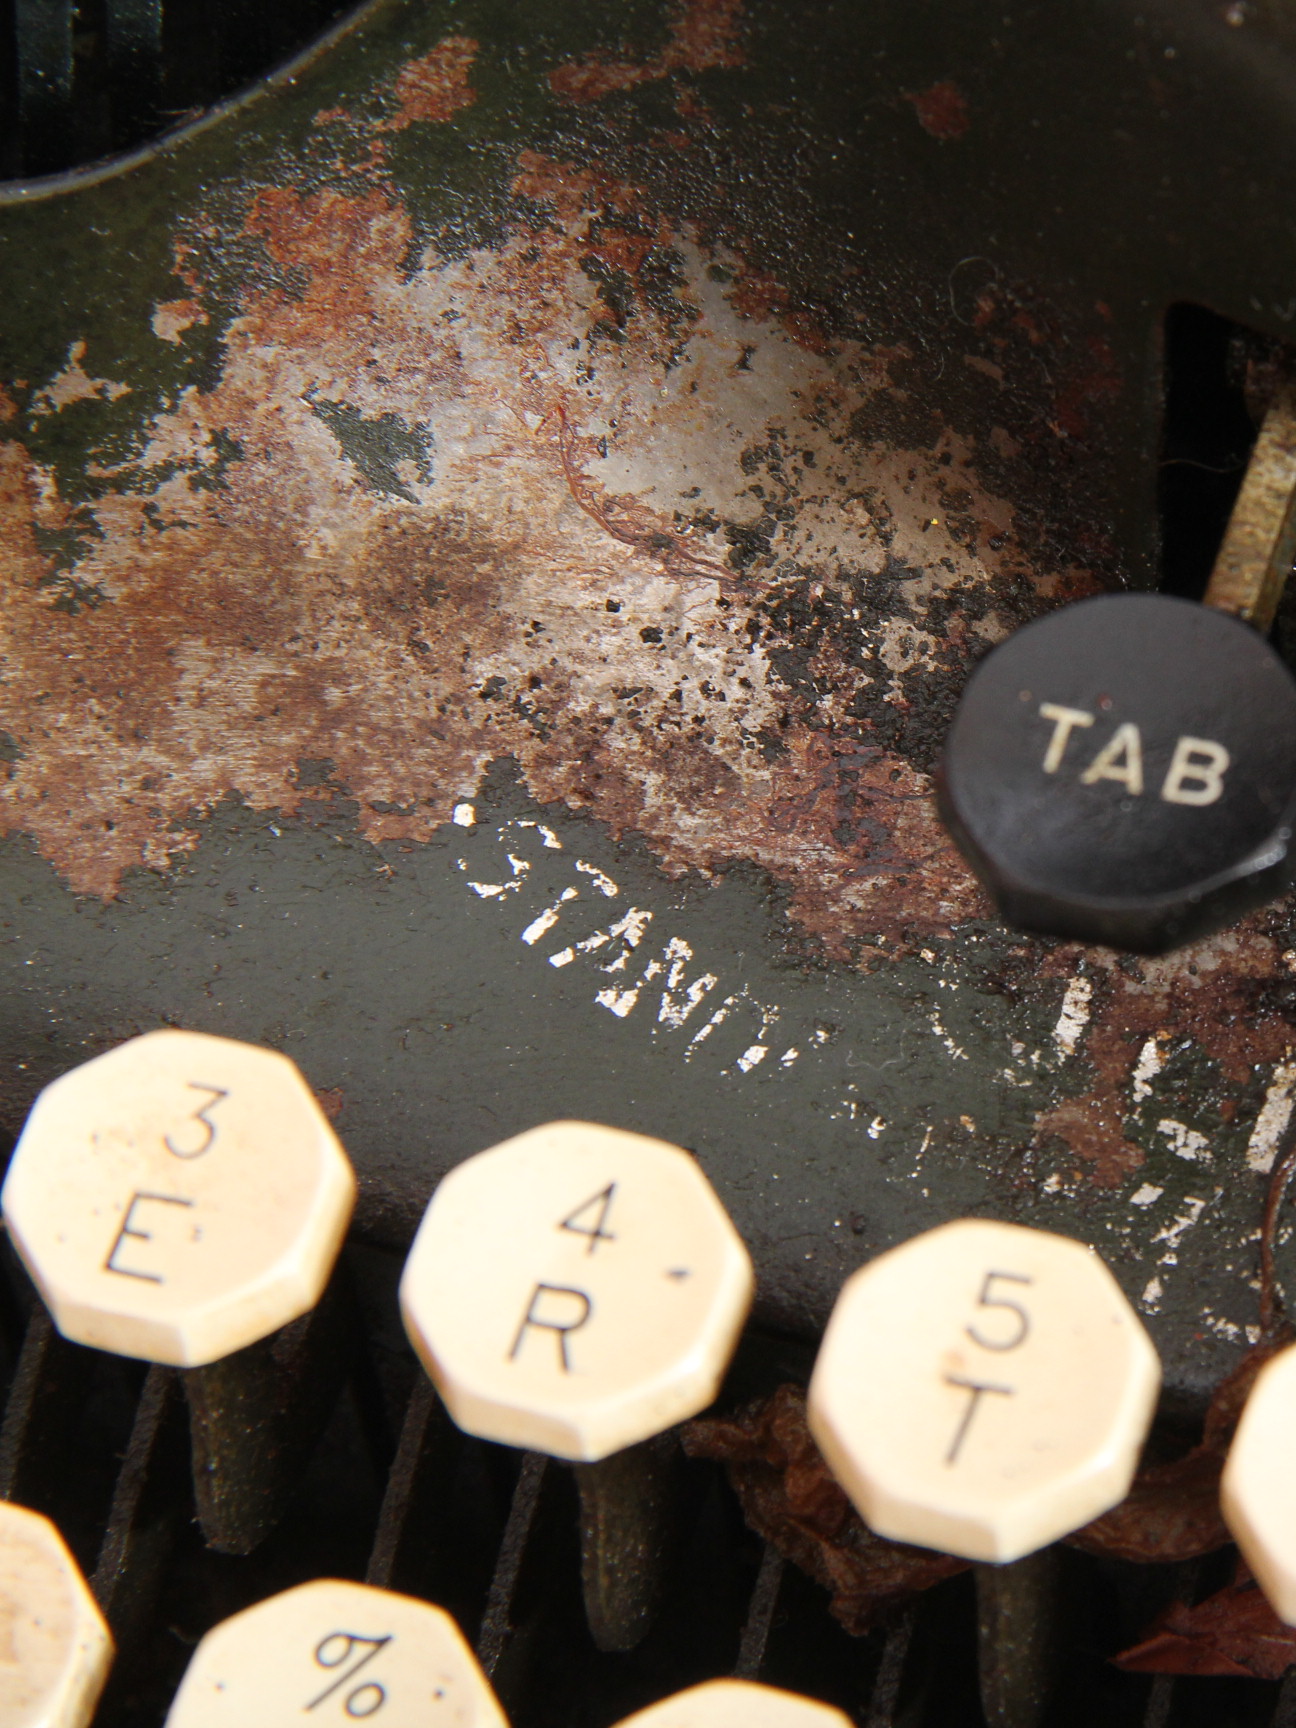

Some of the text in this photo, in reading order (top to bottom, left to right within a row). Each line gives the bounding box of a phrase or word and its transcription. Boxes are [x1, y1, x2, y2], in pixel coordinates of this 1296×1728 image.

[1036, 702, 1232, 808] TAB
[163, 1082, 229, 1160] 3
[103, 1191, 194, 1285] E
[557, 1181, 617, 1256] 4
[507, 1281, 594, 1373] R
[964, 1270, 1034, 1352] 5
[941, 1373, 1013, 1466] T
